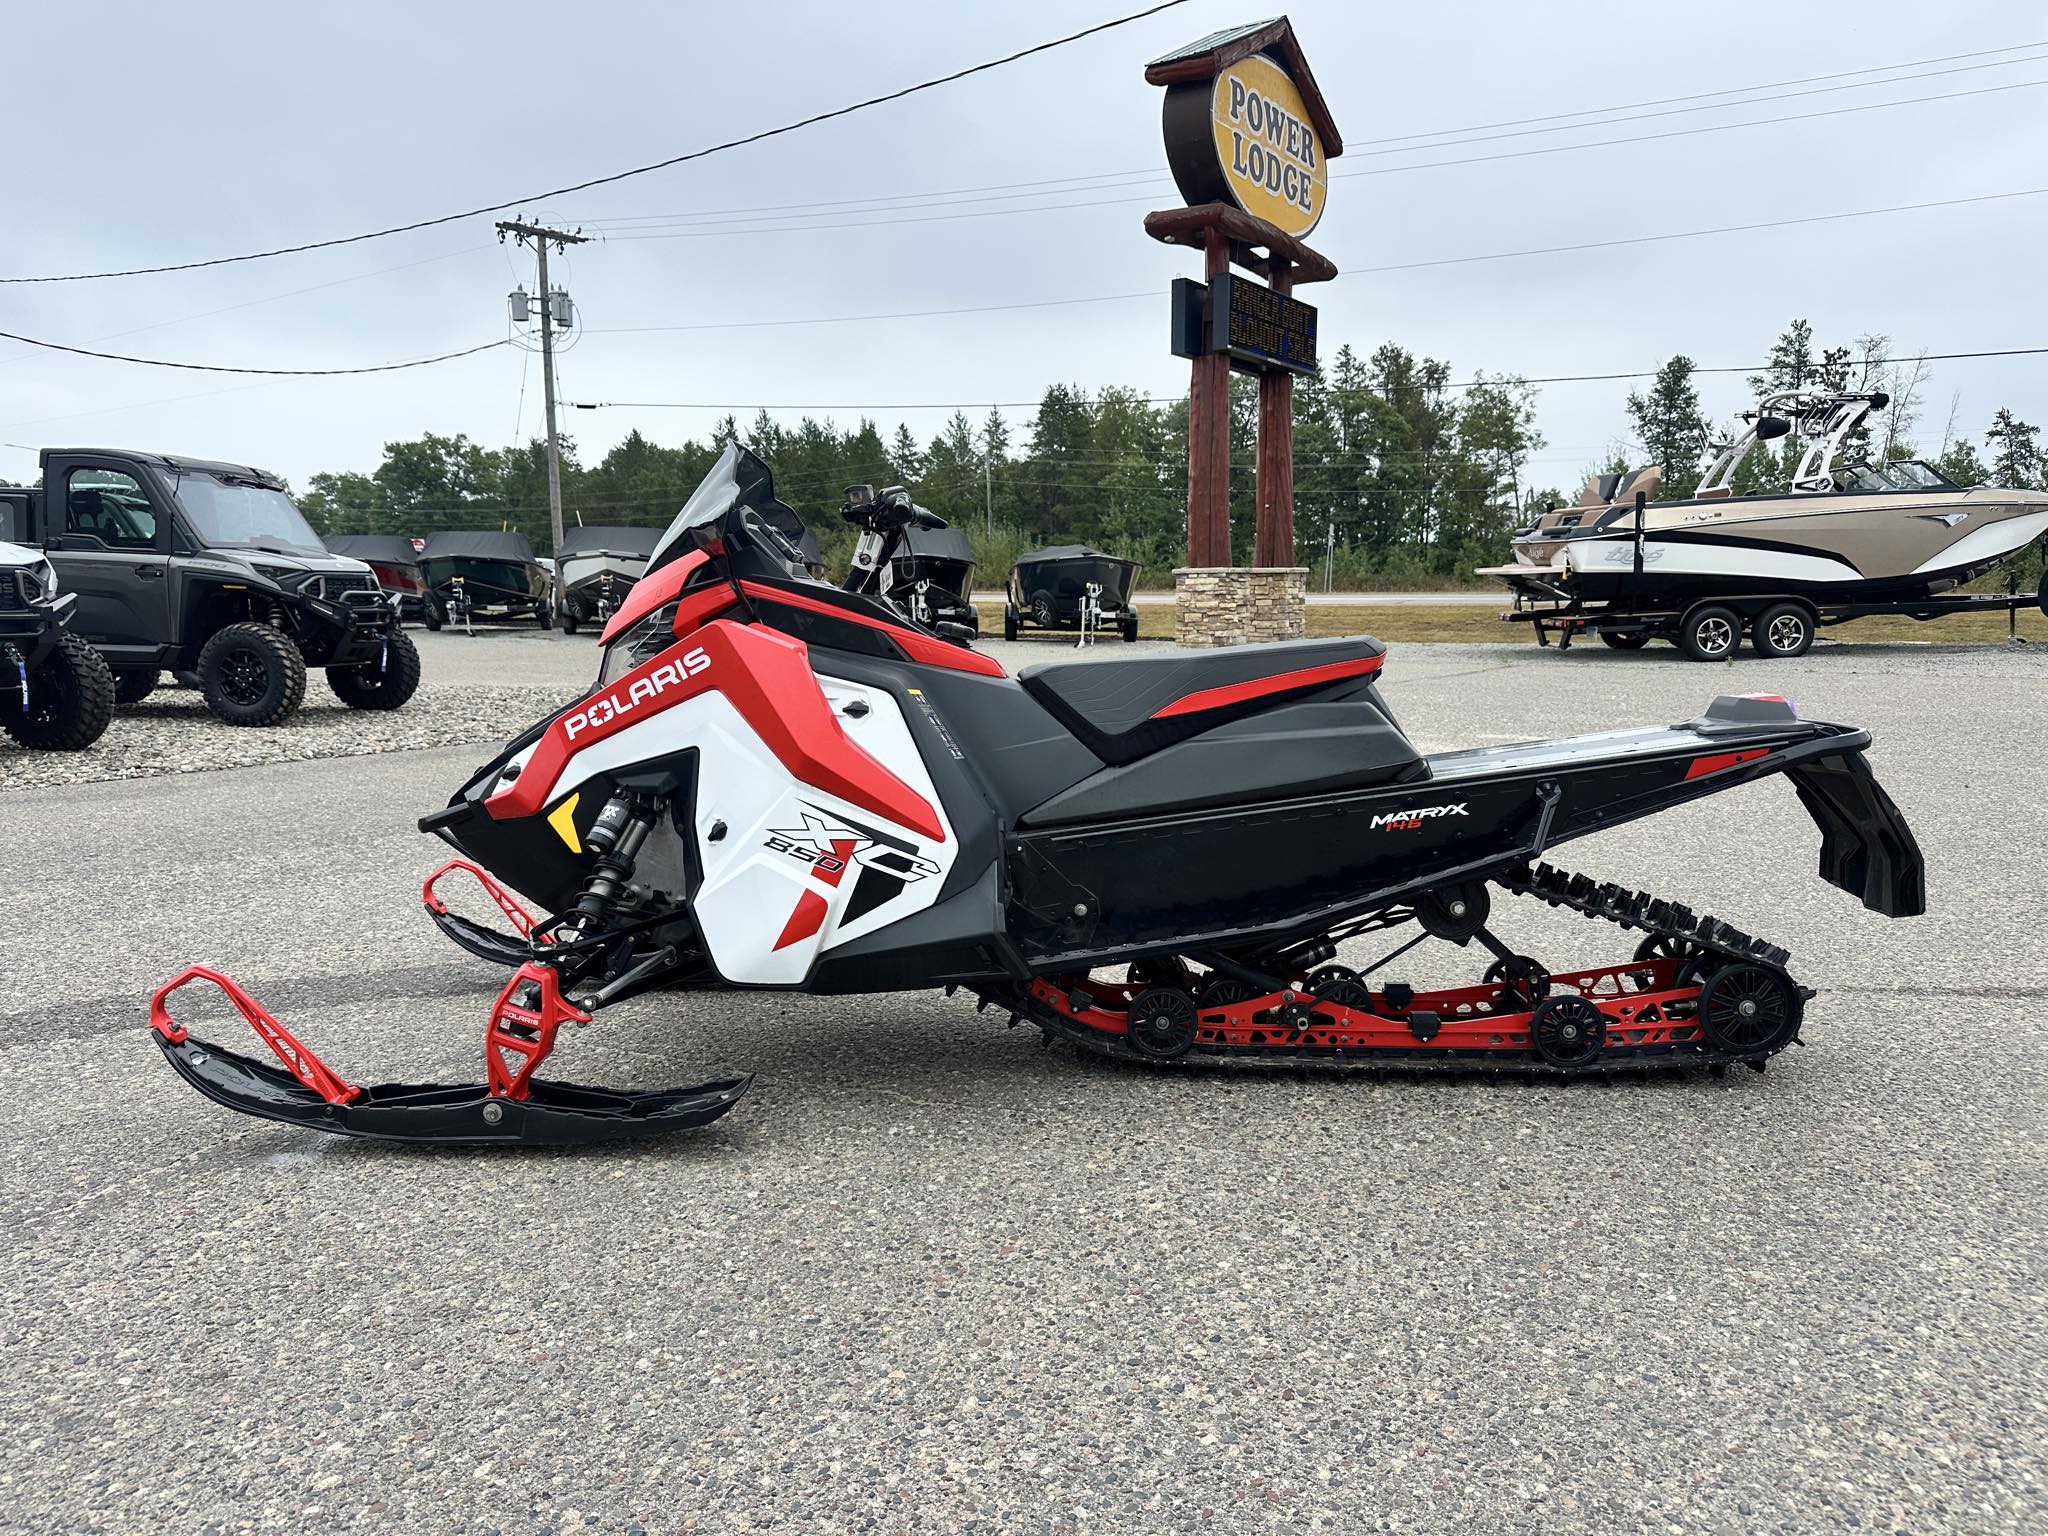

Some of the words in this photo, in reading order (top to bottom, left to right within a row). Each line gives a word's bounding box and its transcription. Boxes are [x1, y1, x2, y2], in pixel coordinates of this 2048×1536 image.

[1229, 76, 1316, 169] POWER
[1232, 131, 1313, 211] LODGE
[564, 646, 712, 741] POLARIS
[1369, 802, 1470, 829] MATRYX
[1385, 818, 1422, 832] 146
[763, 836, 844, 872] 850
[502, 1010, 539, 1026] POLARIS
